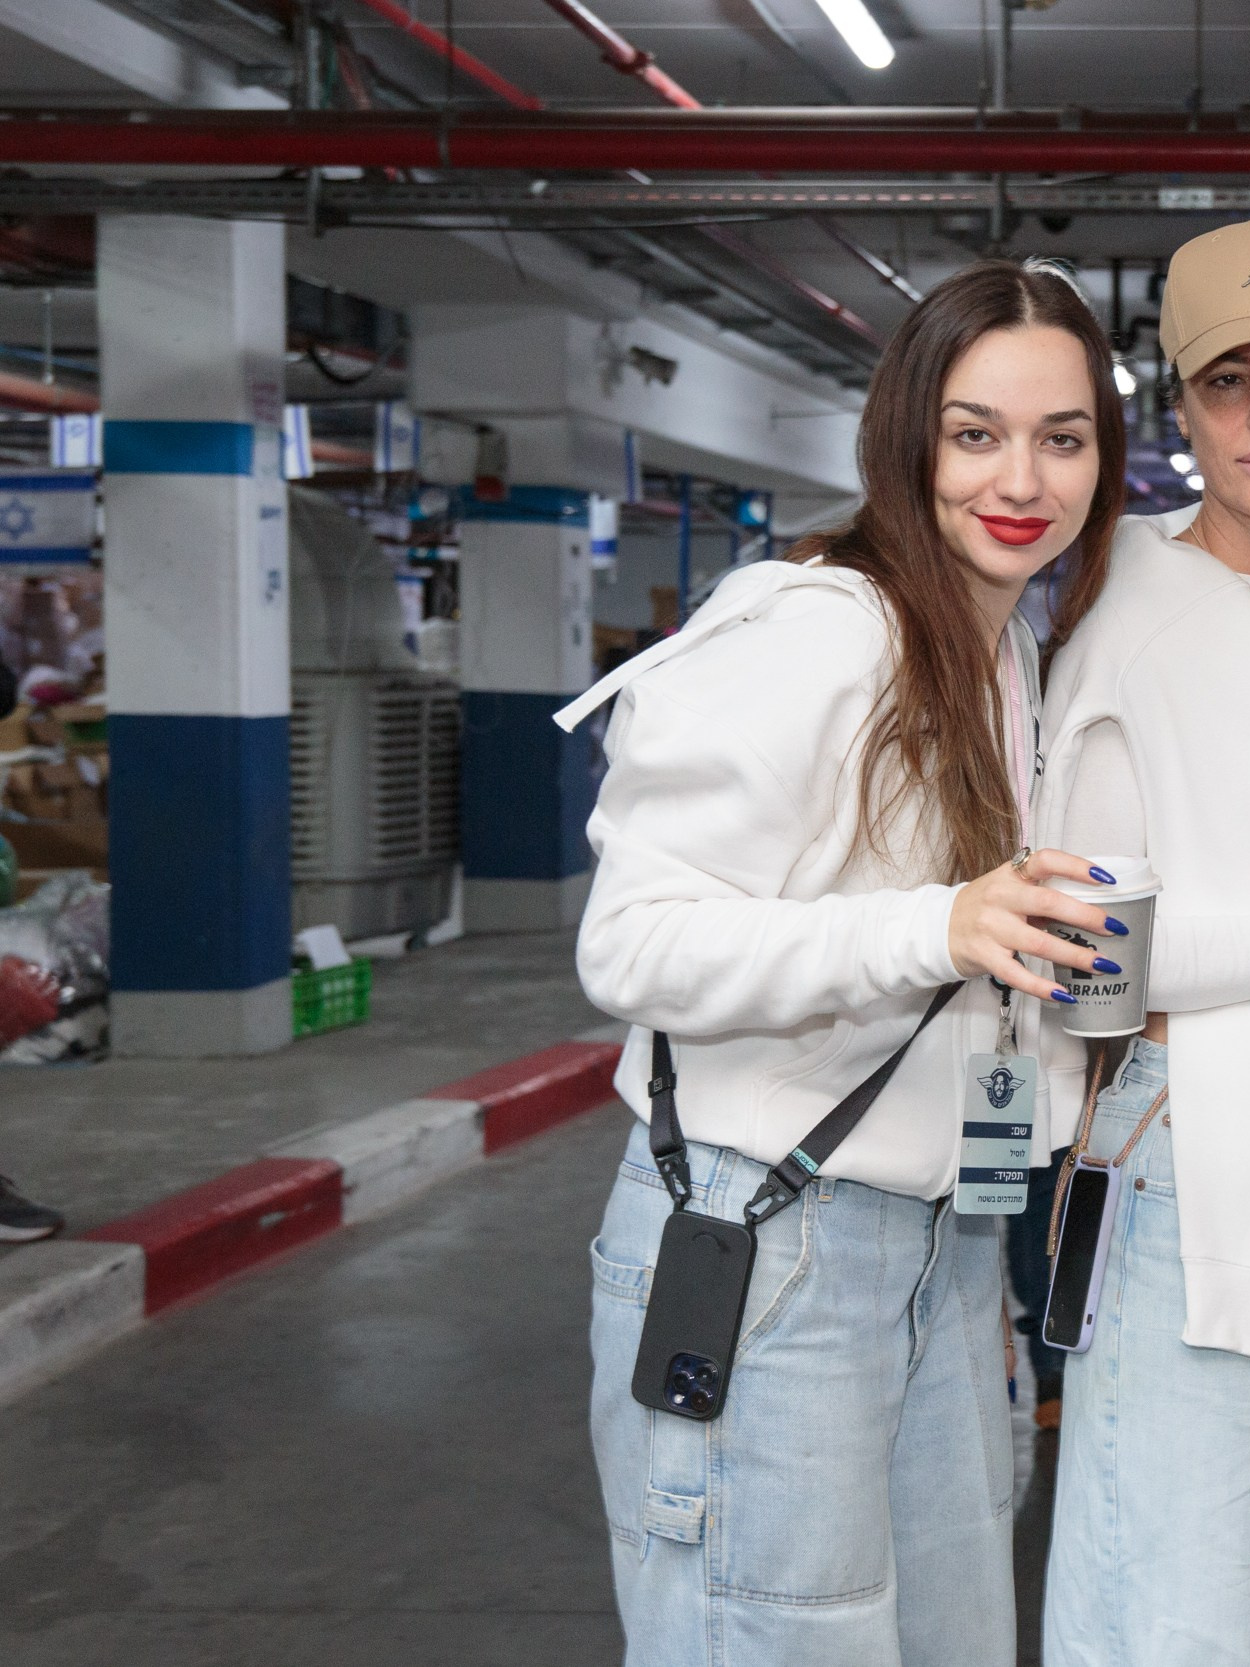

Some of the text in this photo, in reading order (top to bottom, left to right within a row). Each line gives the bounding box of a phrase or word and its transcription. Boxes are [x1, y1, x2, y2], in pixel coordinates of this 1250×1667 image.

[1011, 1126, 1027, 1136] שם:
[994, 1171, 1024, 1182] תפקיד:
[977, 1195, 1023, 1203] מתנדבים בשטח
